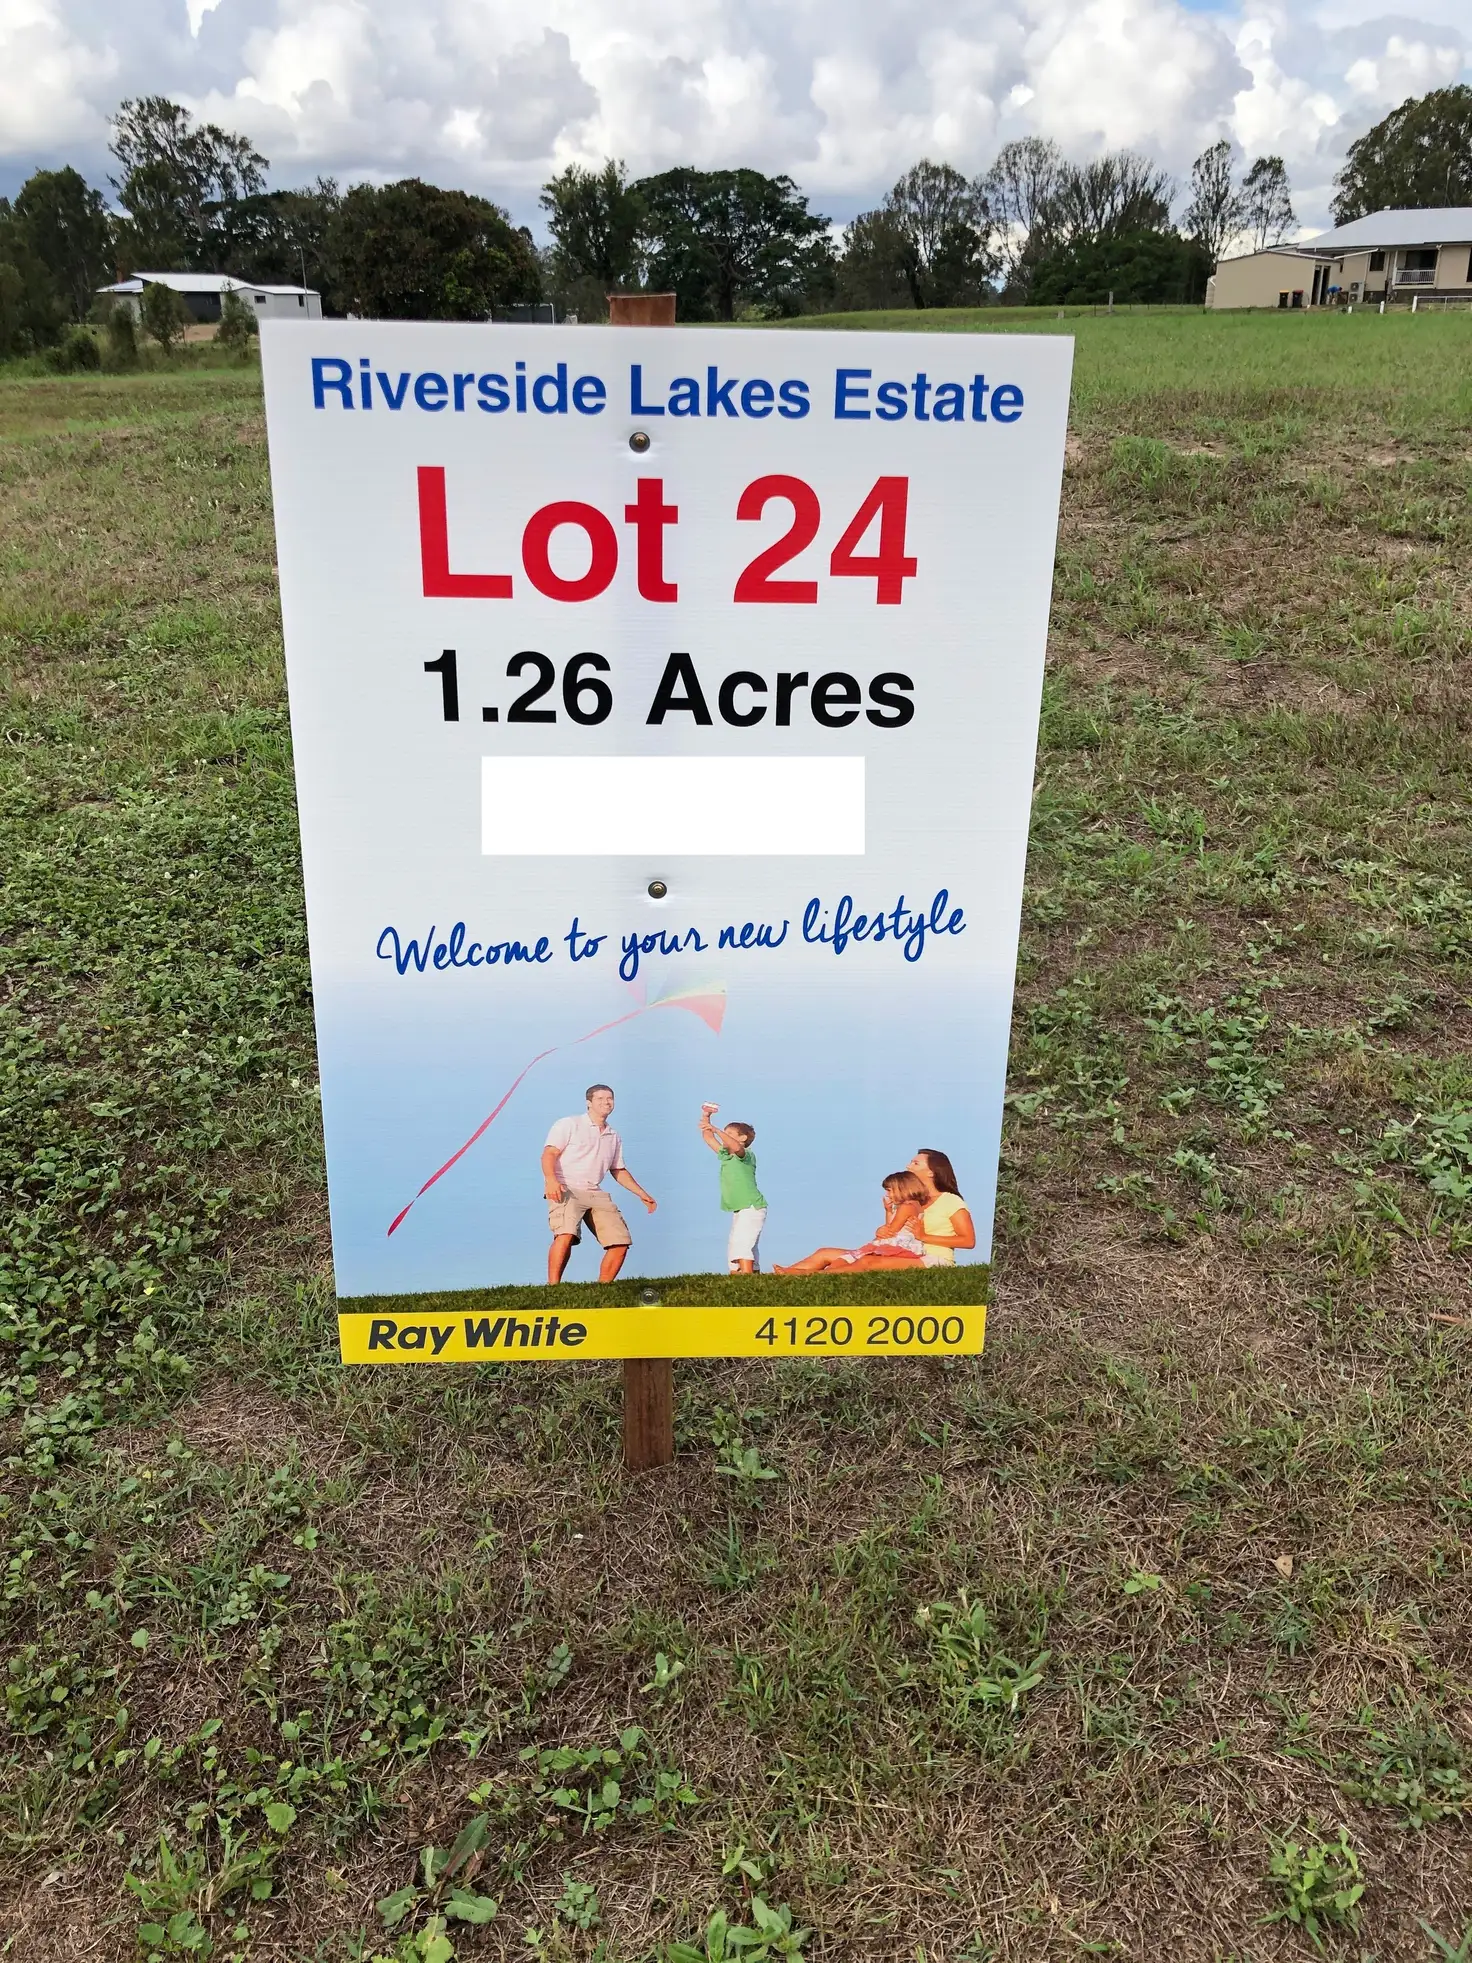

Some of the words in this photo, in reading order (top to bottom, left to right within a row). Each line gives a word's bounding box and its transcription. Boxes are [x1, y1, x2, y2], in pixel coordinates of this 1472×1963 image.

[311, 357, 608, 416] Riverside
[630, 364, 811, 420] Lakes
[834, 368, 1025, 424] Estate
[416, 465, 679, 604] Lot
[733, 474, 919, 606] 24
[423, 649, 613, 726] 1.26
[645, 652, 915, 729] Acres
[376, 921, 554, 976] Welcome
[563, 916, 608, 962] to
[618, 927, 709, 982] your
[717, 919, 791, 950] new
[802, 888, 967, 963] lifestyle
[367, 1318, 457, 1357] Ray
[463, 1315, 588, 1348] White
[754, 1316, 854, 1347] 4120
[865, 1315, 965, 1346] 2000
